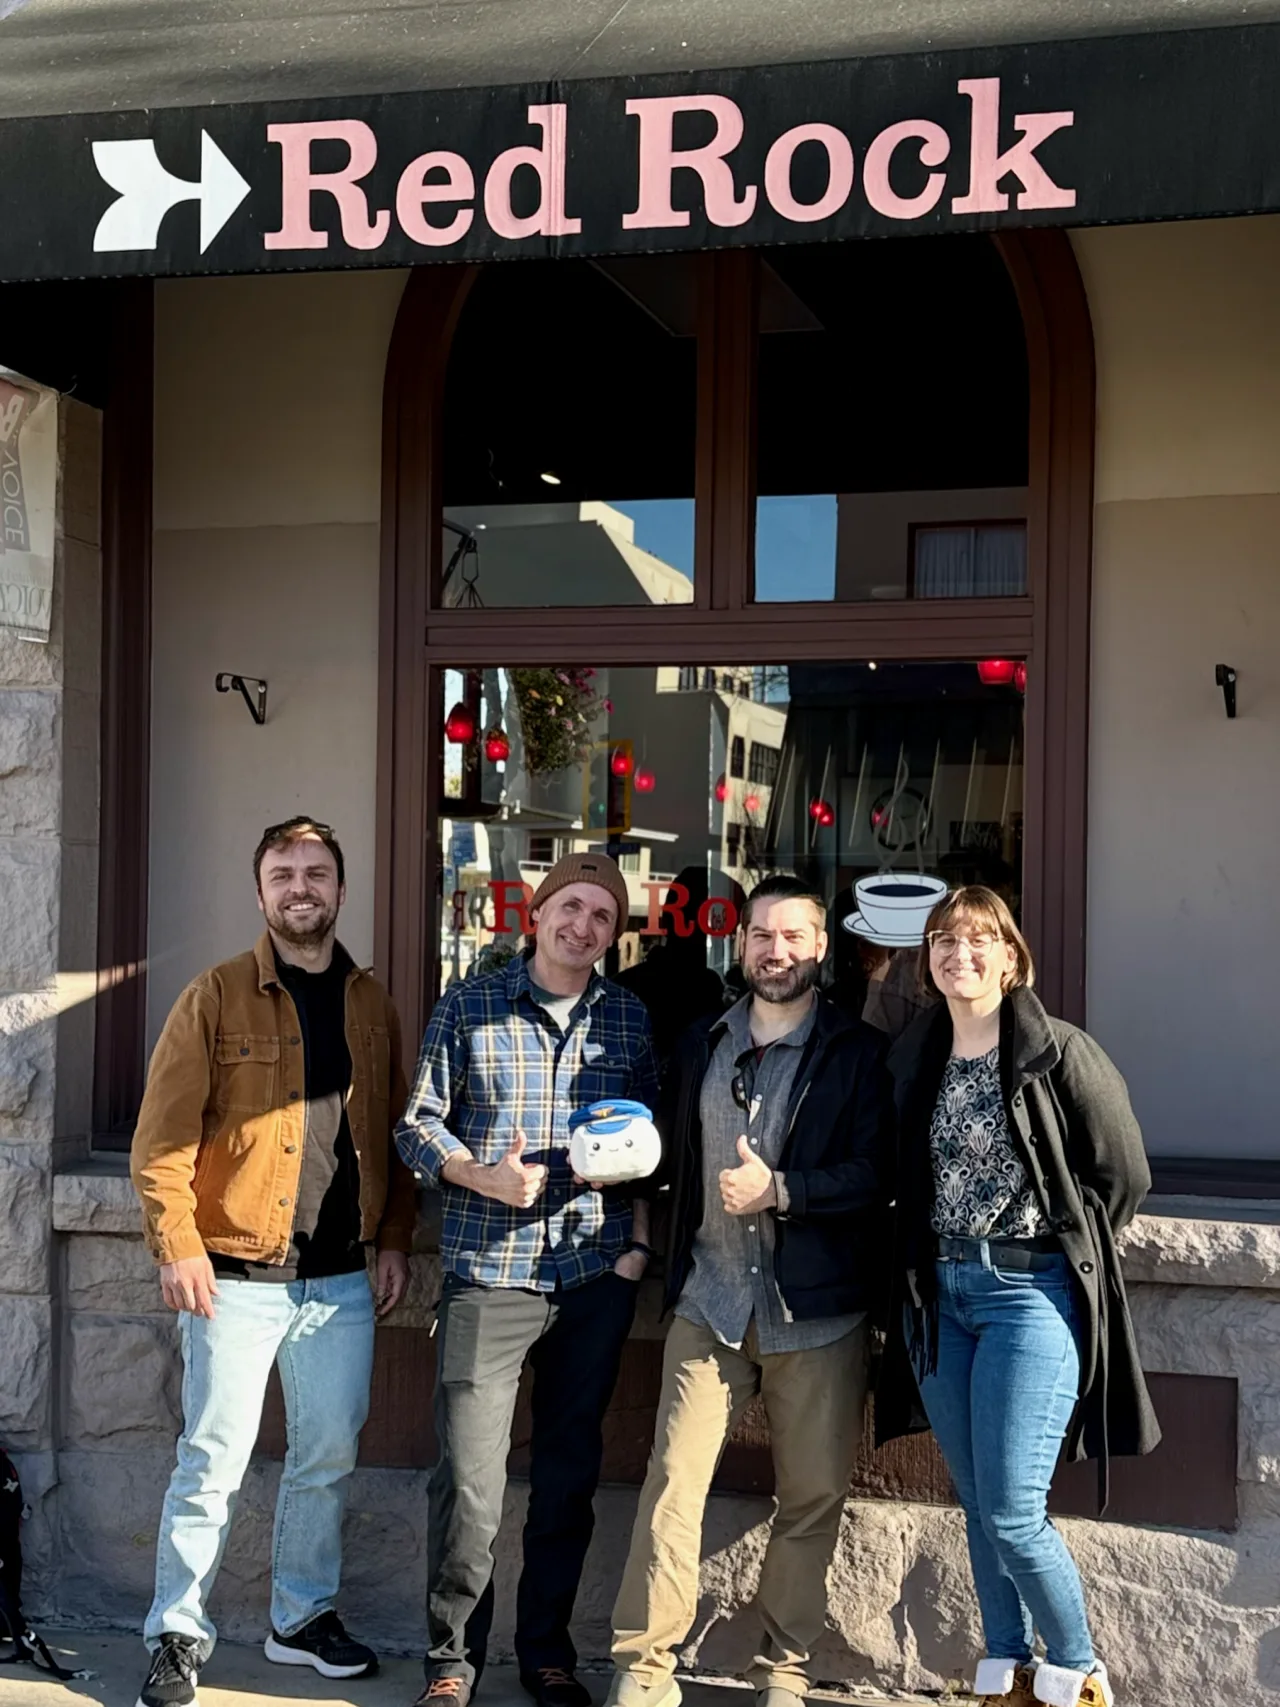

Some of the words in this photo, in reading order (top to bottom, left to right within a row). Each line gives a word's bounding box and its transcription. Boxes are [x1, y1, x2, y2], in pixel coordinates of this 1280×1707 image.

[264, 103, 582, 250] Red
[622, 77, 1076, 229] Rock
[640, 882, 737, 937] Ro
